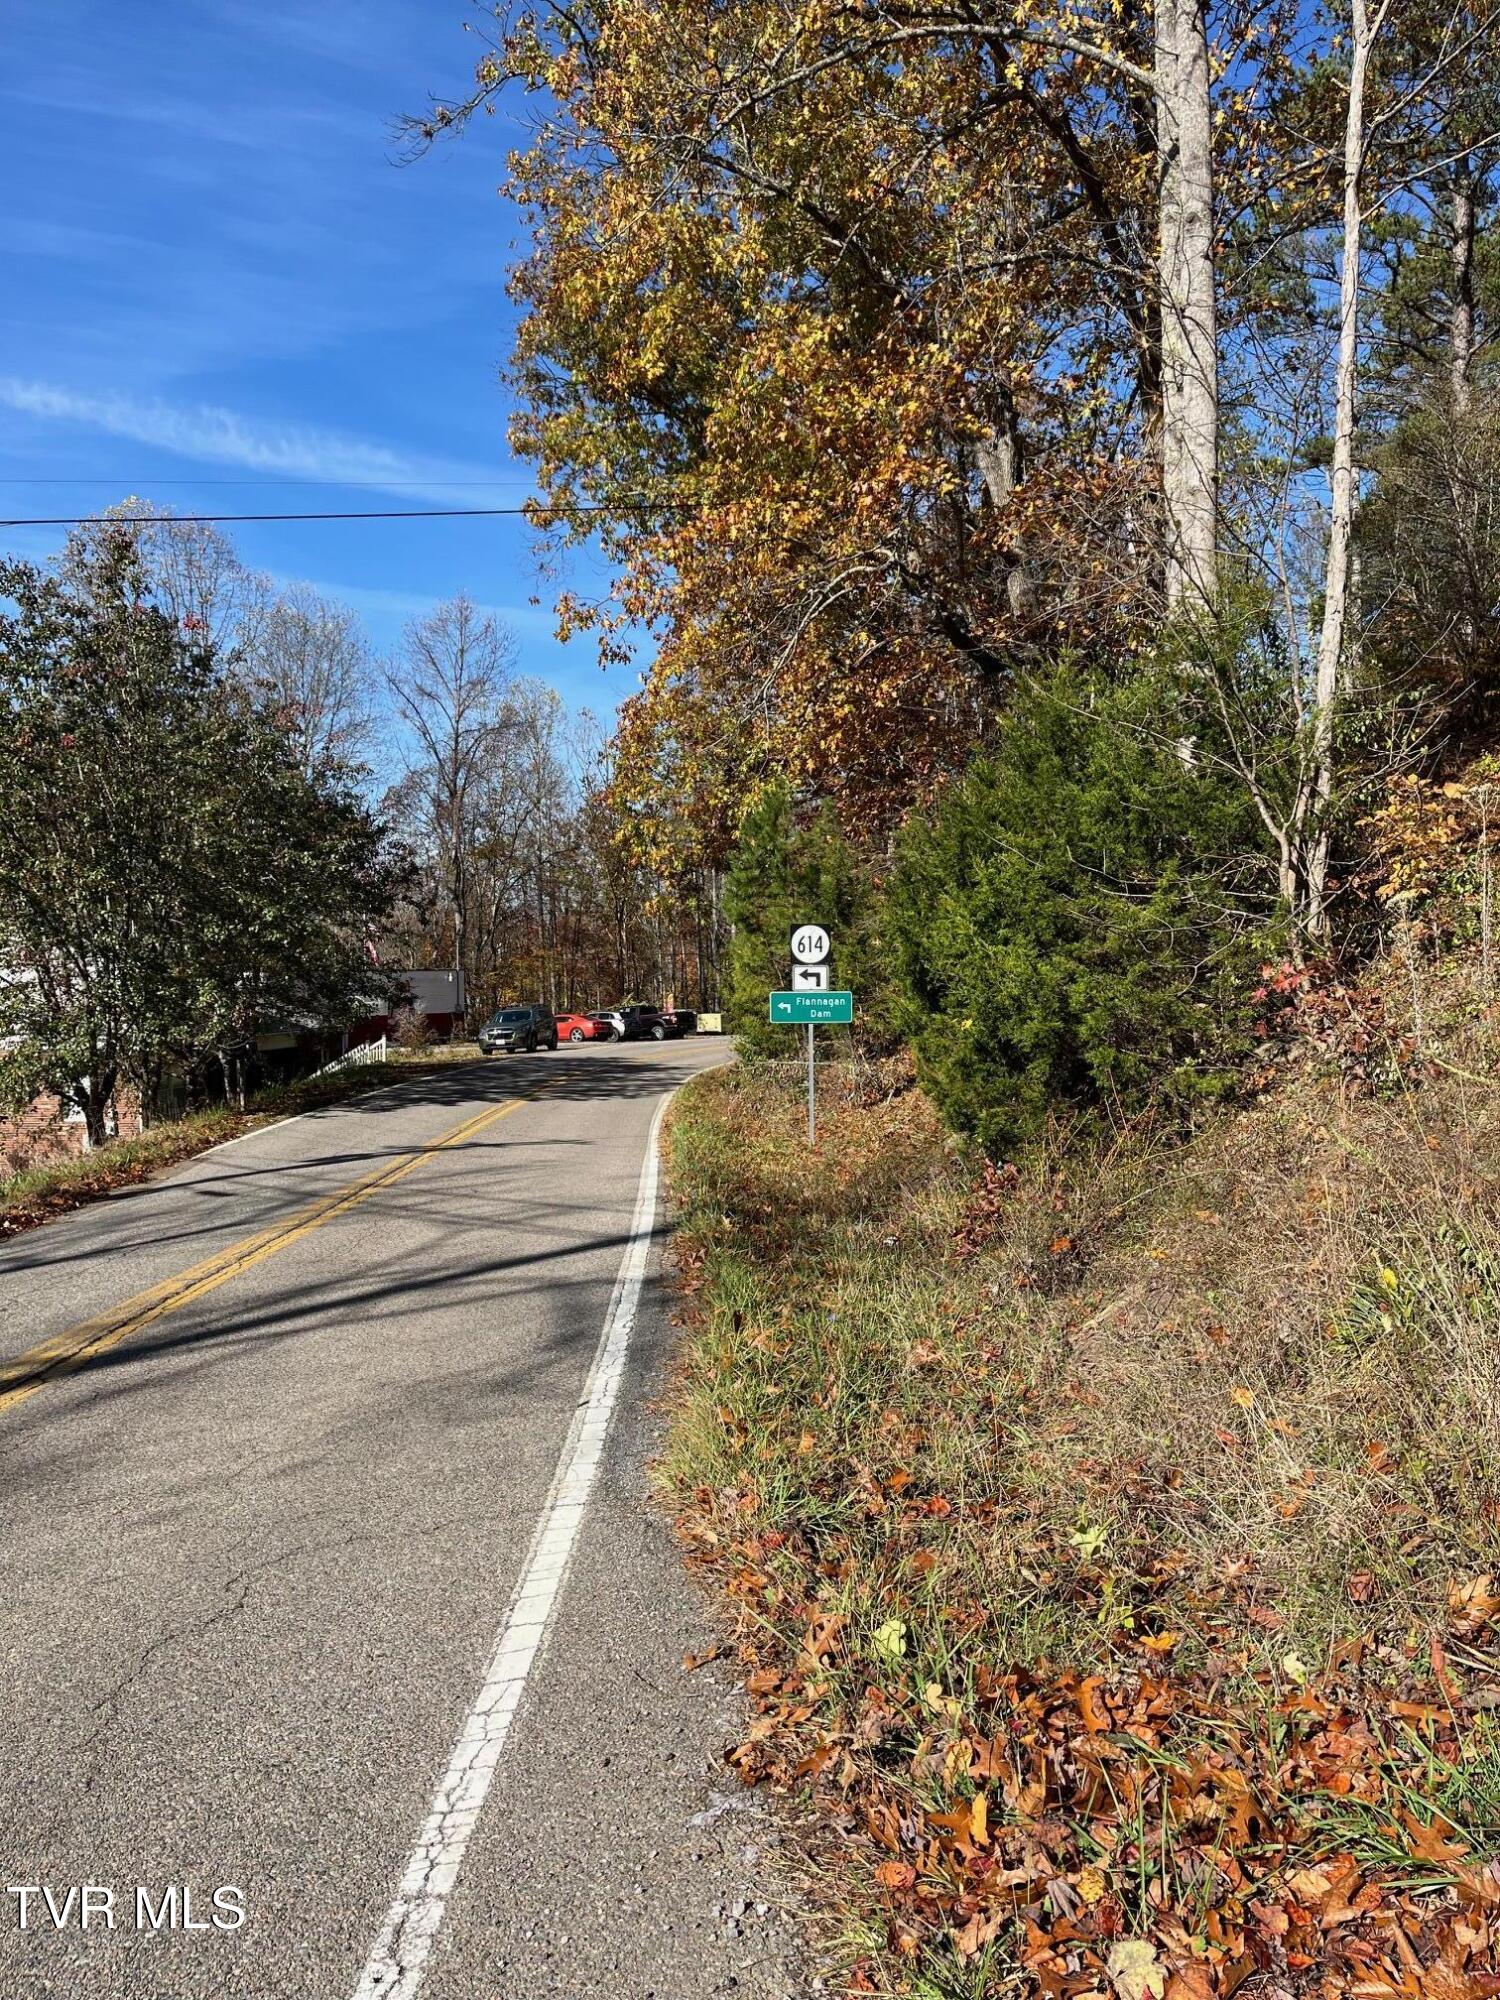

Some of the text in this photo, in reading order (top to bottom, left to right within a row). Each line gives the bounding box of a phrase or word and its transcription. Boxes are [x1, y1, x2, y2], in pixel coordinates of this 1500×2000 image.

[798, 935, 823, 953] 614
[796, 997, 845, 1007] Flannagan
[810, 1010, 831, 1018] Dam
